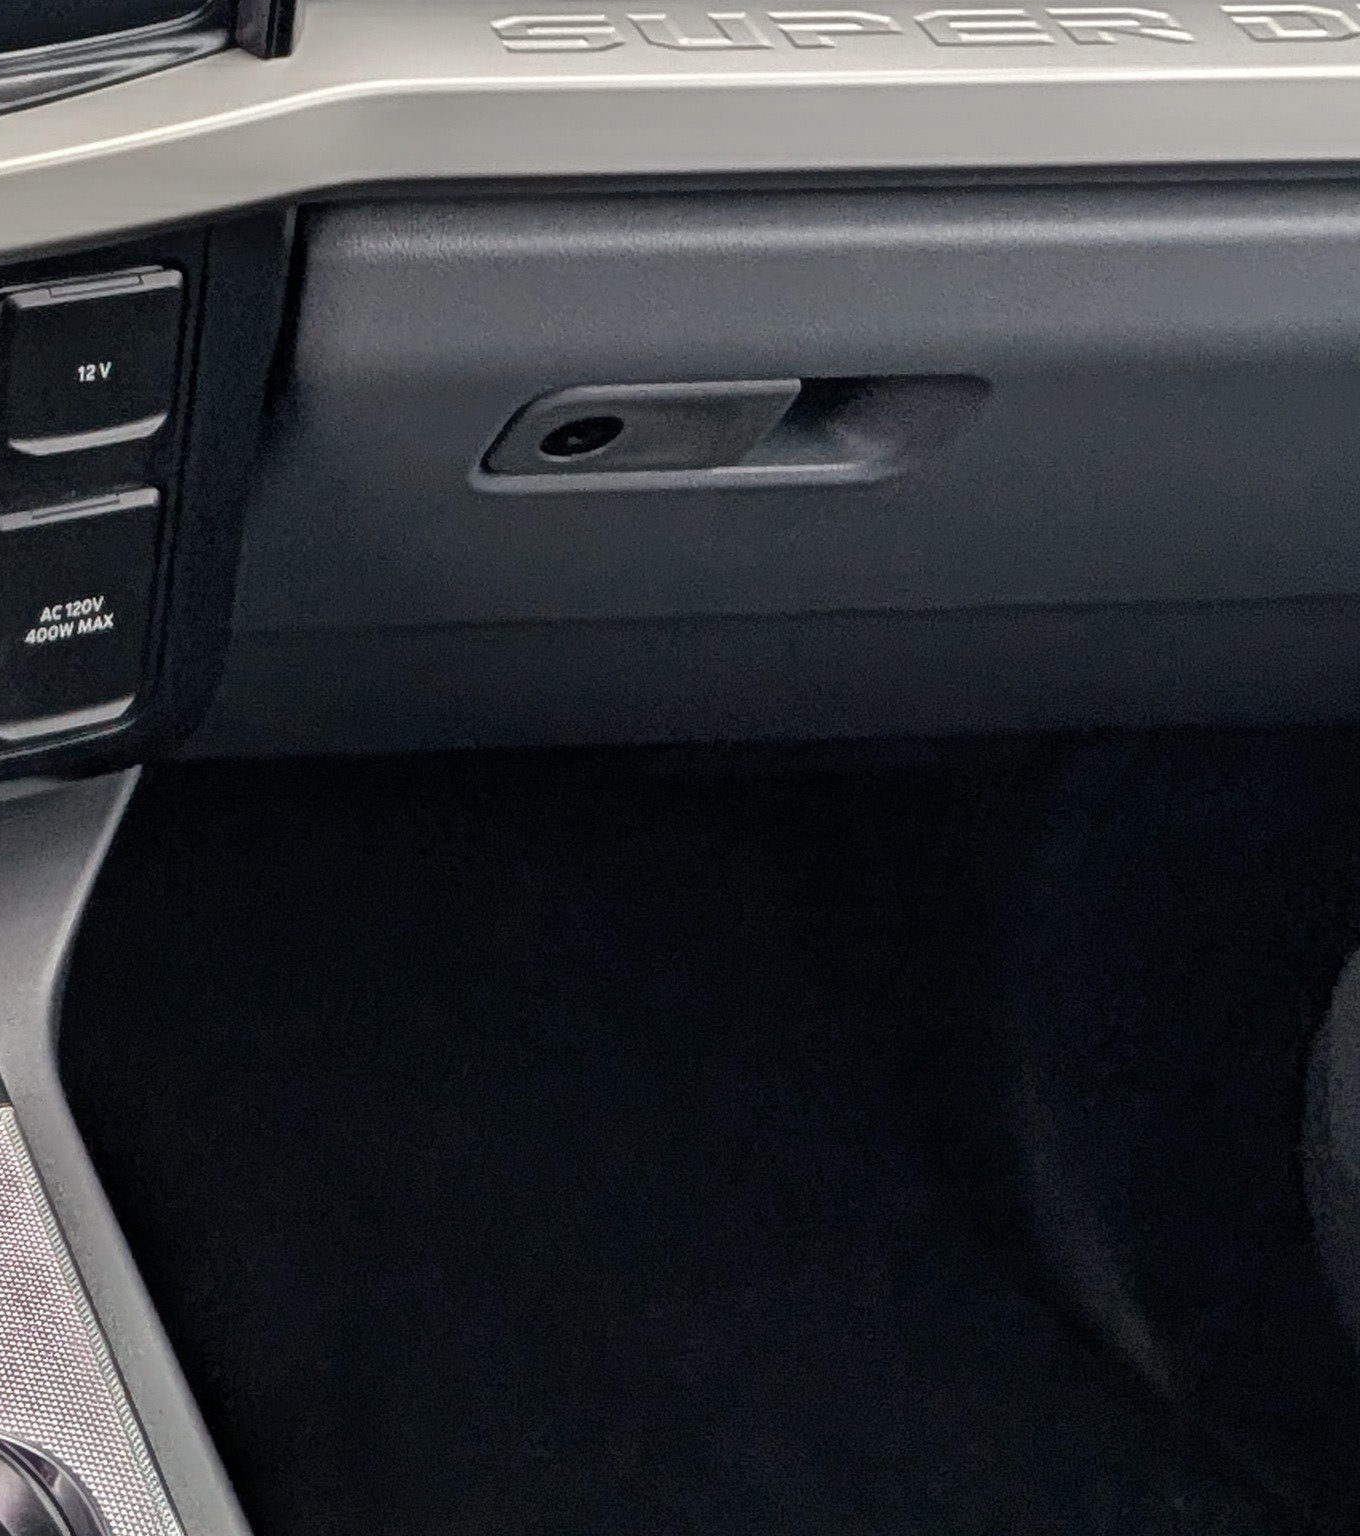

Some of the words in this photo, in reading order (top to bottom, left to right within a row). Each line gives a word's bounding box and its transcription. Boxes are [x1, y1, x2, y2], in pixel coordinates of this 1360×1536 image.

[490, 6, 1196, 52] SUPER
[1220, 3, 1360, 43] D
[77, 364, 96, 382] 12
[99, 361, 112, 380] V
[40, 604, 62, 623] AC
[65, 596, 104, 618] 120V
[24, 621, 74, 644] 400W
[77, 613, 114, 635] MAX
